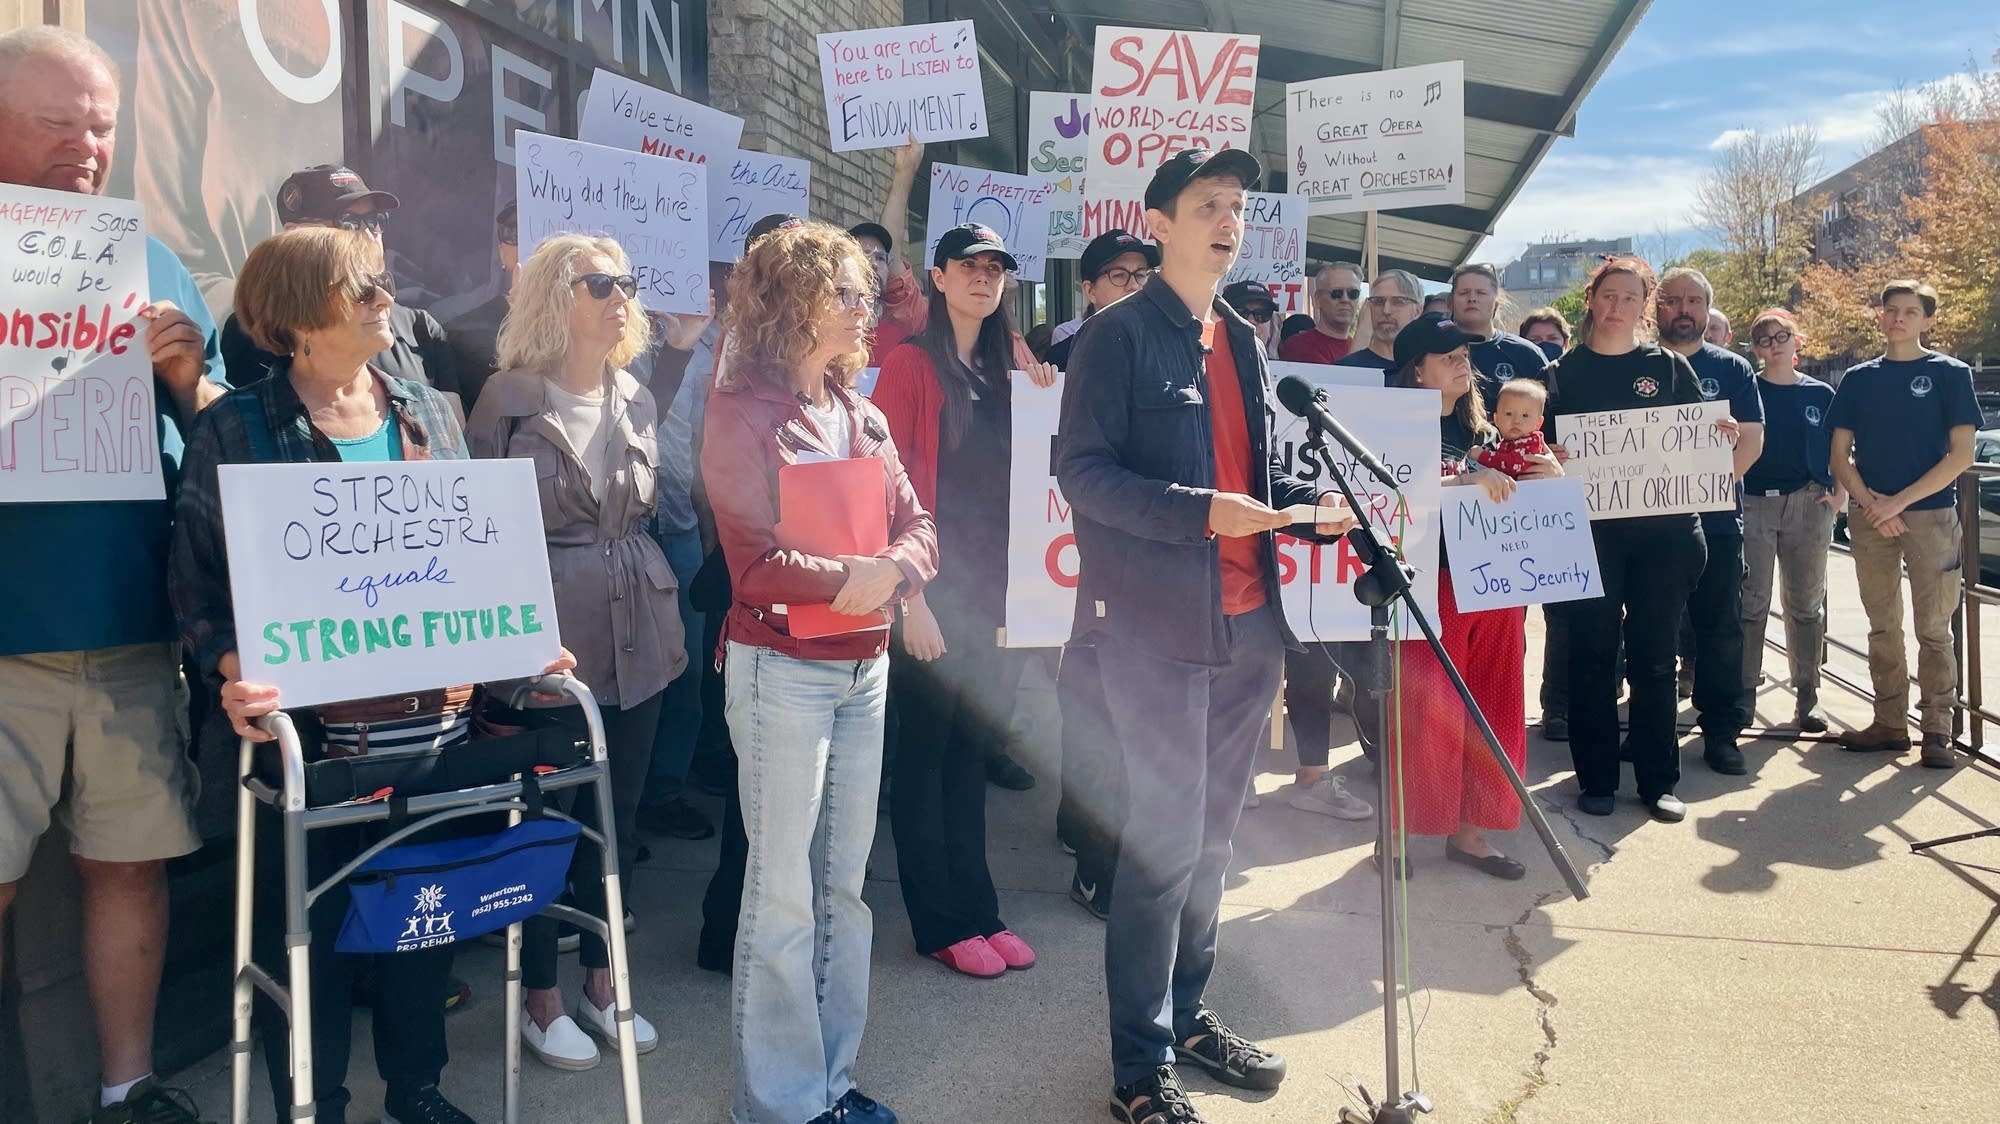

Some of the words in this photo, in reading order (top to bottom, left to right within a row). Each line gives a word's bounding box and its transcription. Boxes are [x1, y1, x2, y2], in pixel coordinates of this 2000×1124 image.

[825, 39, 869, 64] You
[874, 41, 900, 58] are
[909, 32, 944, 54] not
[835, 67, 870, 86] here
[876, 63, 893, 81] to
[956, 54, 974, 70] to
[1101, 31, 1259, 106] SAVE
[611, 87, 658, 128] Value
[663, 113, 693, 137] the
[1290, 89, 1343, 112] There
[1361, 90, 1372, 102] is
[1389, 87, 1404, 99] no
[1094, 106, 1247, 133] WORLD-CLASS
[1316, 122, 1368, 141] GREAT
[1397, 152, 1406, 161] a
[731, 160, 758, 185] the
[527, 167, 573, 220] Why
[581, 177, 606, 210] did
[614, 175, 647, 224] they
[90, 212, 139, 242] Says
[12, 267, 62, 288] would
[77, 270, 112, 292] be
[1575, 412, 1629, 429] THERE
[1645, 410, 1660, 424] IS
[1677, 405, 1703, 422] NO
[1562, 427, 1650, 460] GREAT
[1661, 463, 1671, 475] A
[312, 474, 470, 517] STRONG
[1458, 499, 1576, 541] Musicians
[283, 516, 500, 561] ORCHESTRA
[1500, 540, 1529, 553] NEED
[334, 556, 457, 607] equals
[1520, 557, 1590, 592] Security
[263, 613, 413, 666] STRONG
[420, 603, 544, 648] FUTURE
[471, 904, 492, 918] (952)
[493, 893, 533, 911] 955-2242
[480, 883, 527, 903] Watertown
[396, 942, 418, 953] PRO
[420, 935, 456, 949] REHAB
